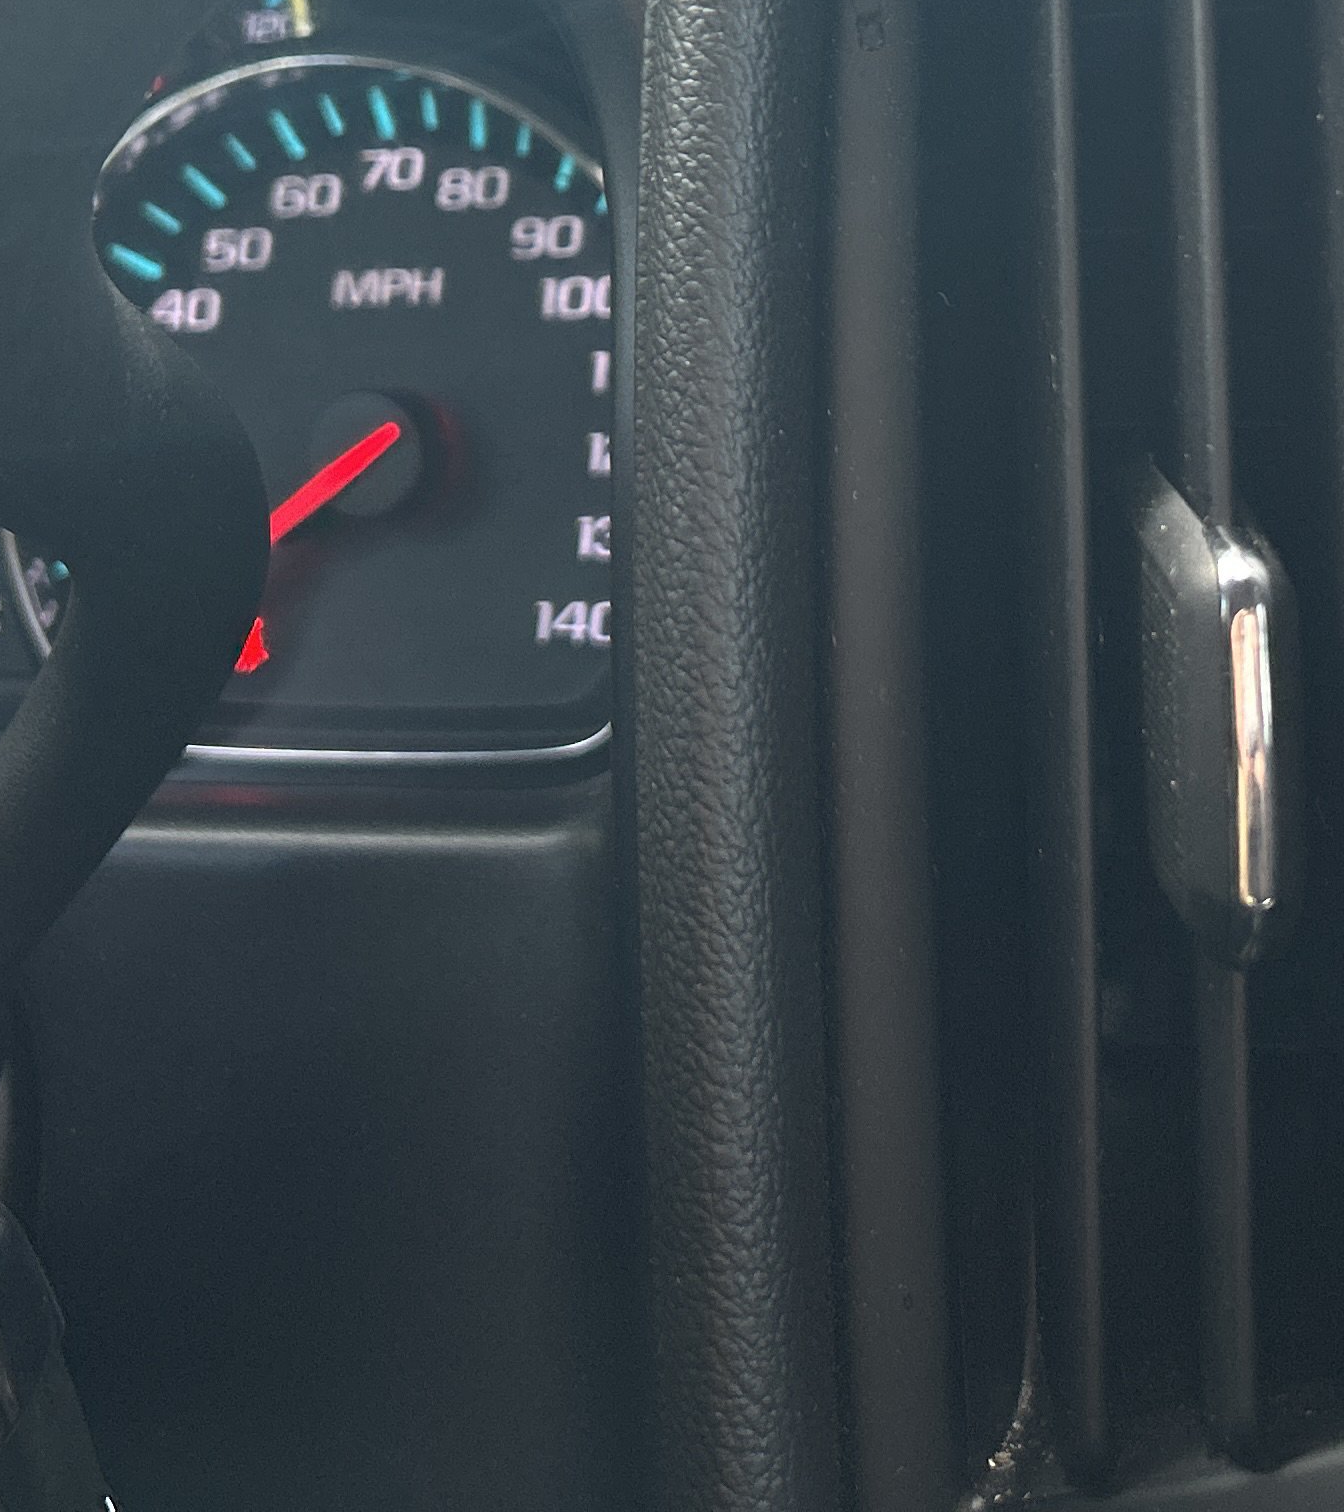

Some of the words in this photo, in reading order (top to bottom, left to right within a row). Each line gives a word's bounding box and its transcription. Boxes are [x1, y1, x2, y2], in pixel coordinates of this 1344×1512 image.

[359, 147, 426, 192] 70
[435, 165, 510, 211] 80
[270, 173, 344, 219] 60
[202, 226, 274, 273] 50
[510, 215, 584, 261] 90
[152, 288, 222, 333] 40
[330, 267, 446, 310] MPH
